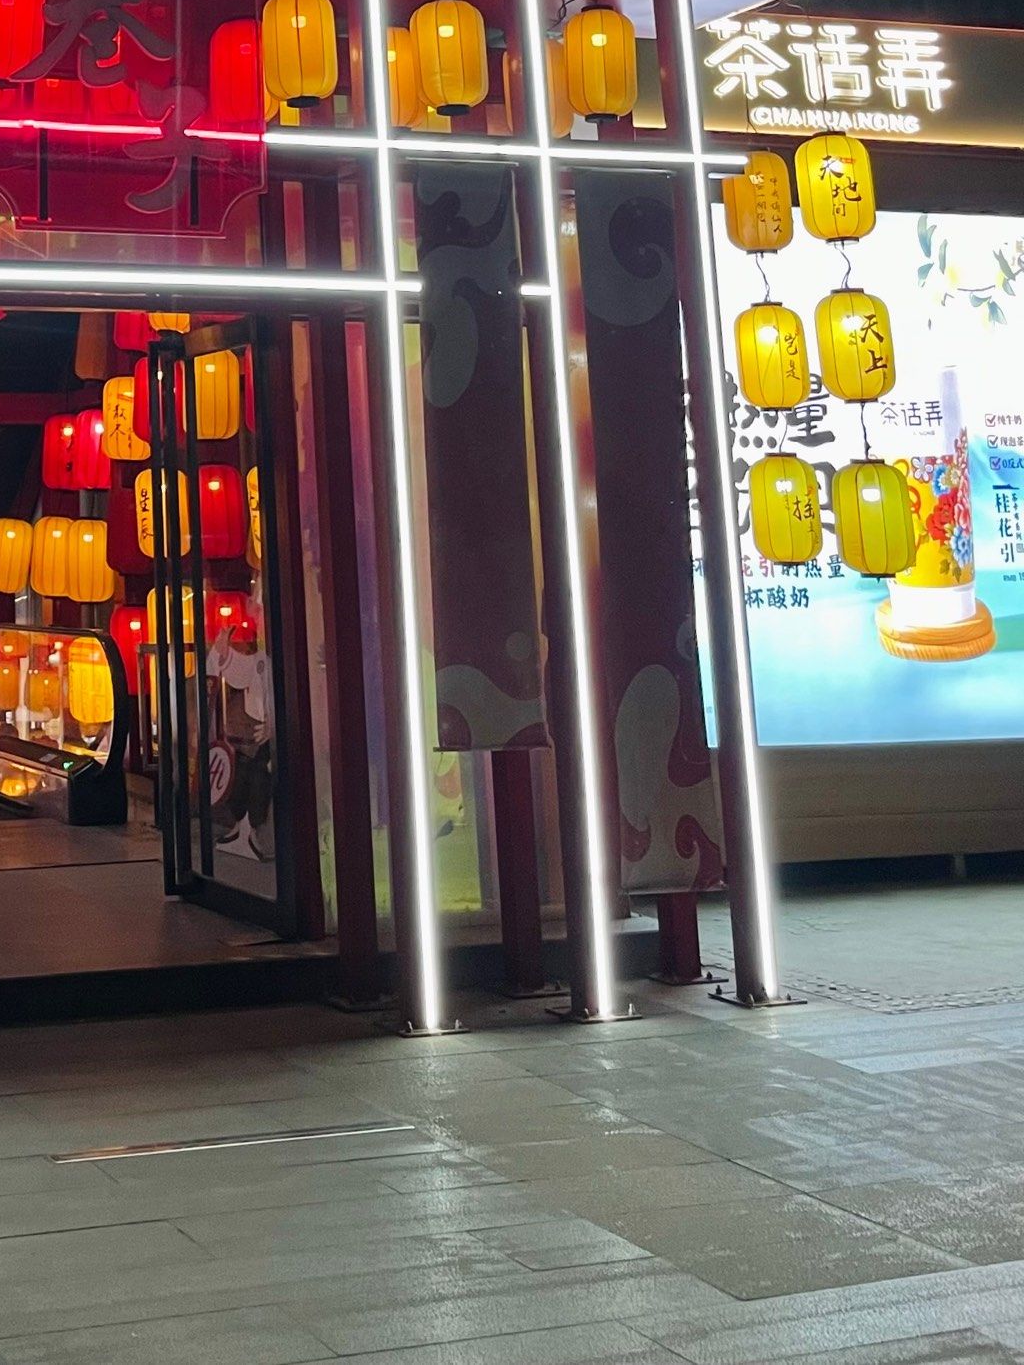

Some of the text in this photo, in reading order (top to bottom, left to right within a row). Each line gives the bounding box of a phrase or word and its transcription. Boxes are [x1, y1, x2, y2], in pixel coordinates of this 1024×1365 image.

[703, 18, 952, 112] 茶话弄
[860, 313, 889, 375] 天上
[880, 400, 943, 427] 茶话弄
[994, 492, 1015, 563] 桂花引
